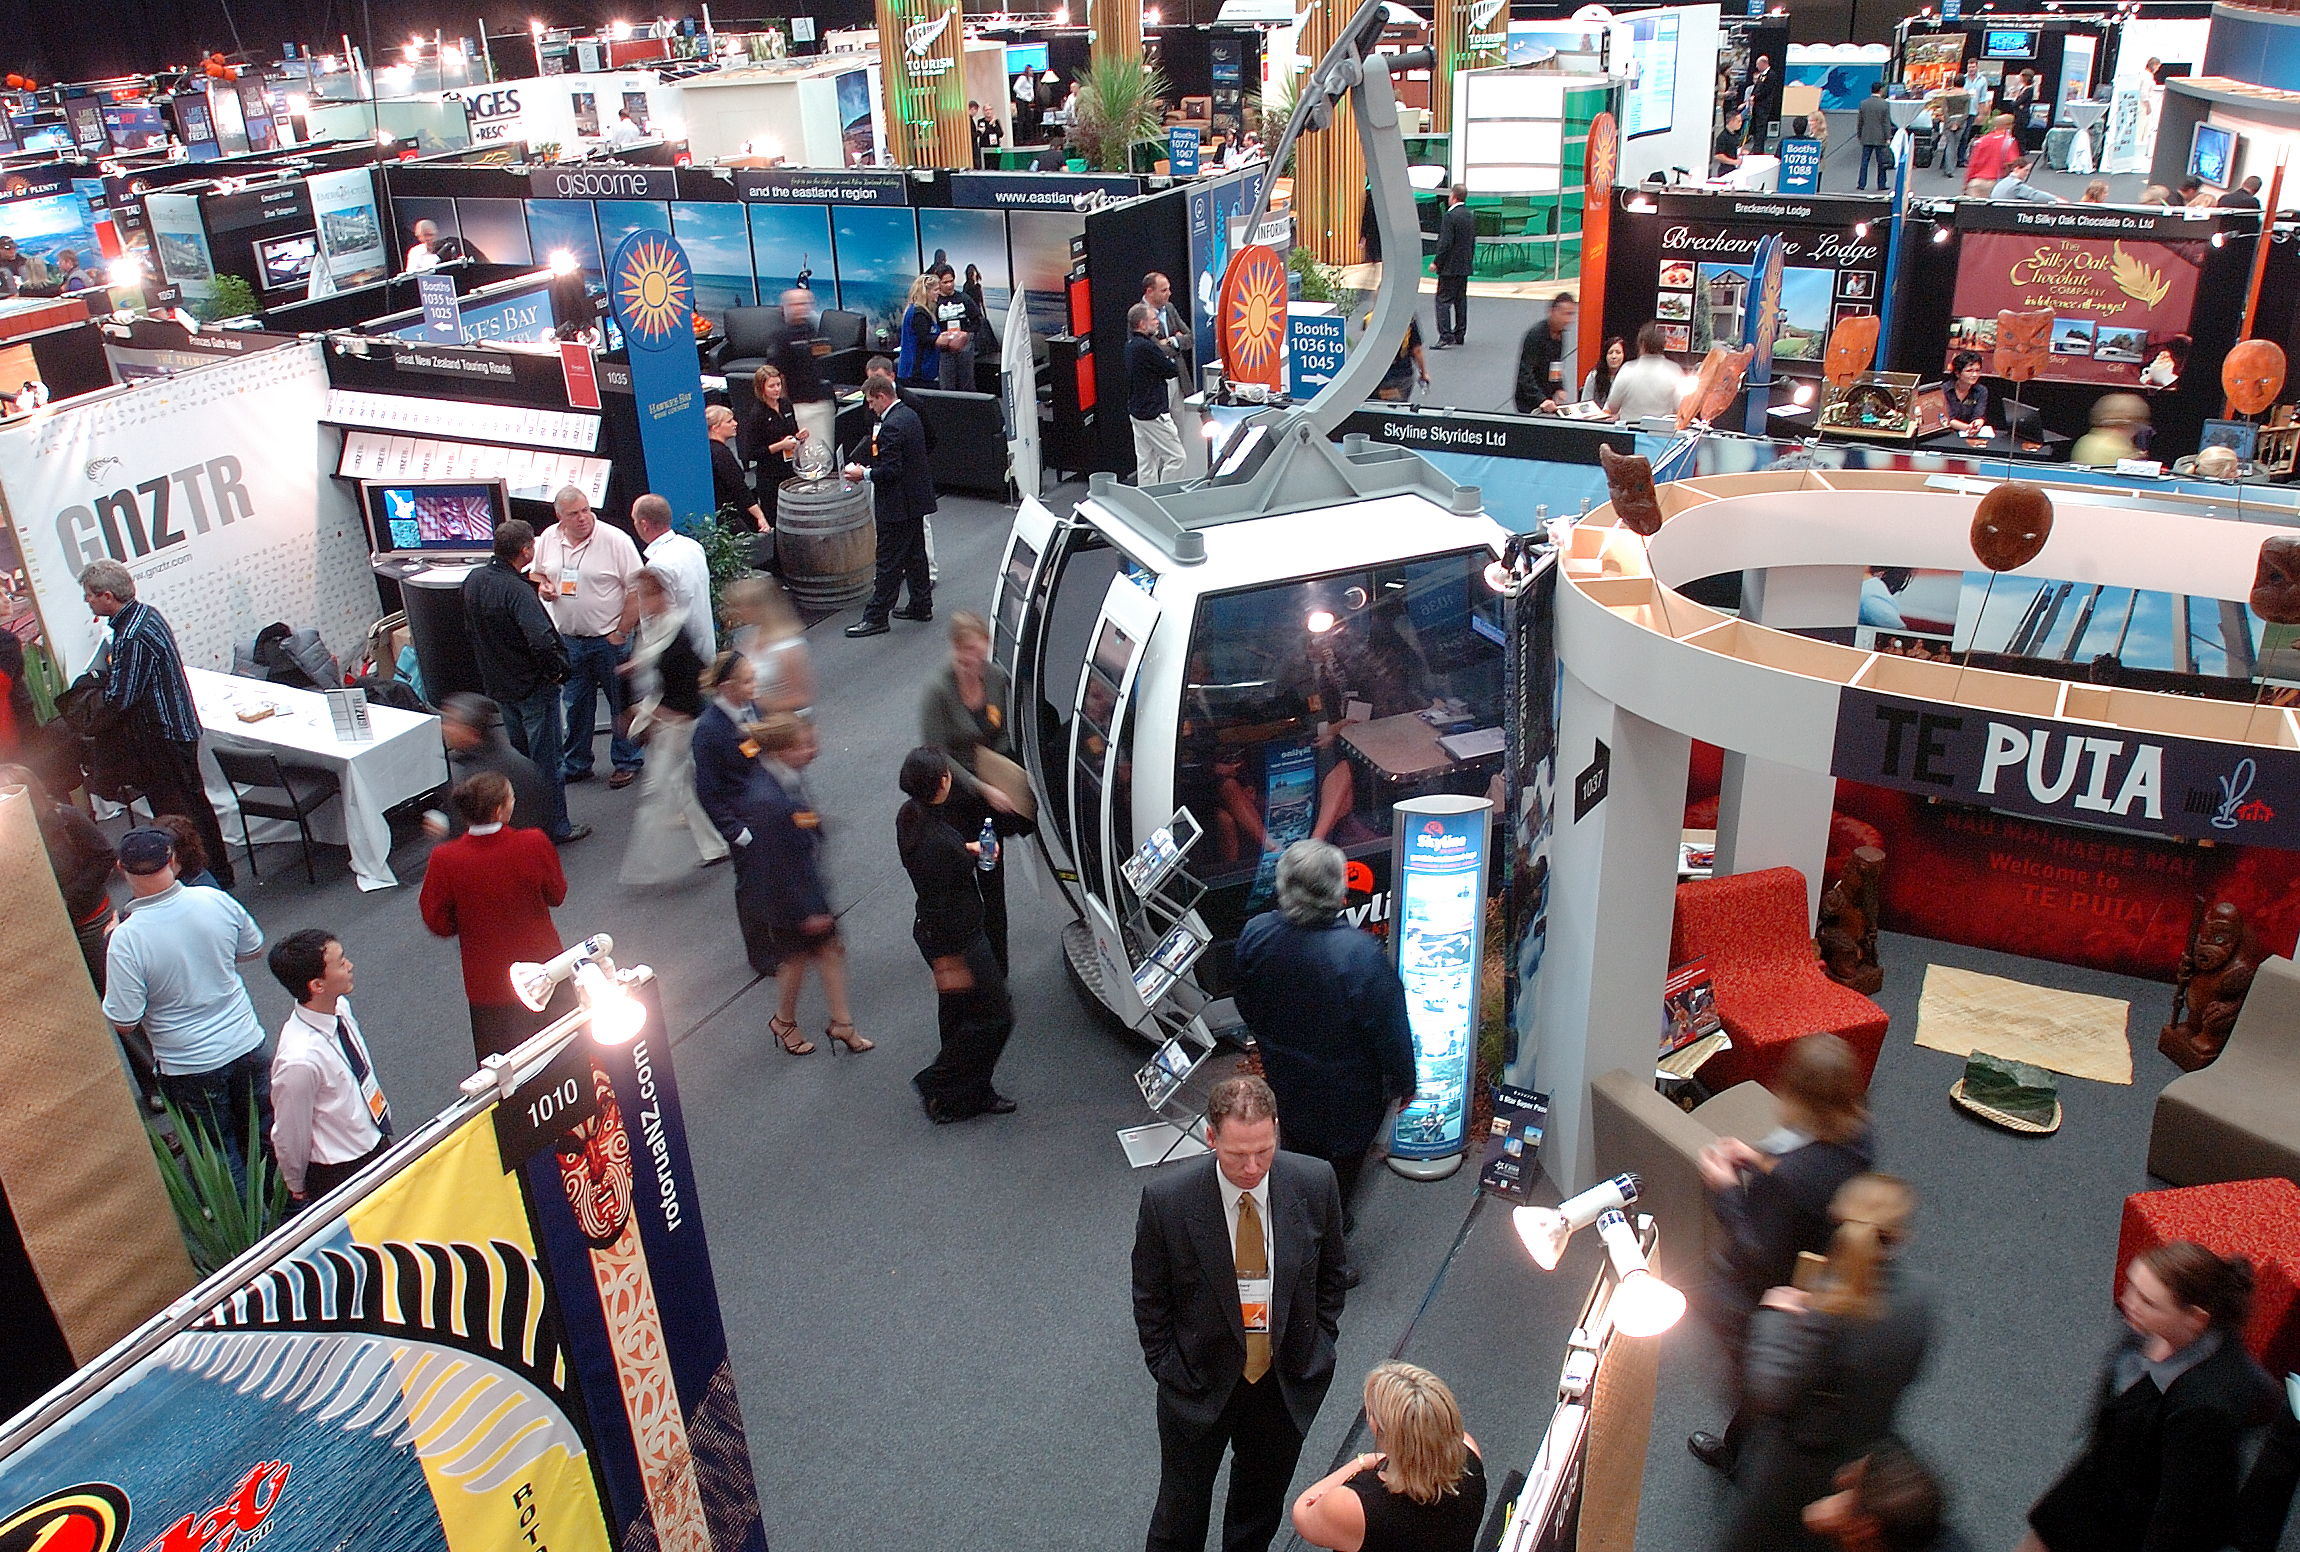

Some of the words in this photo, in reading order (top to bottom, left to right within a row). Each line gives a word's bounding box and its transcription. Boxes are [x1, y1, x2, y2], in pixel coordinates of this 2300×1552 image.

[905, 57, 955, 71] TOURISM
[1787, 143, 1817, 154] Booths
[1784, 154, 1807, 164] 1078
[1808, 155, 1819, 165] to
[29, 183, 60, 195] PLENTY
[556, 169, 648, 199] gisborne
[749, 187, 771, 198] and
[772, 186, 790, 198] the
[792, 186, 839, 199] eastland
[841, 187, 877, 202] region
[1735, 202, 1785, 217] Breckenridge
[1786, 204, 1811, 218] Lodge
[2017, 212, 2034, 224] The
[2034, 213, 2057, 227] Silky
[2058, 214, 2076, 225] Oak
[2077, 215, 2120, 228] Chocolate
[2121, 217, 2137, 229] Co.
[2138, 218, 2155, 230] Ltd
[1806, 233, 1878, 266] Lodge
[2061, 240, 2080, 252] The
[2027, 246, 2073, 273] Silky
[2074, 252, 2110, 271] Oak
[2010, 258, 2093, 286] Chocolate
[422, 280, 451, 292] Booths
[2049, 286, 2107, 297] COMPANY
[422, 294, 446, 306] 1035
[446, 296, 456, 307] to
[430, 307, 452, 320] 1025
[462, 317, 500, 344] KE'S
[1294, 322, 1340, 337] Booths
[1291, 337, 1326, 352] 1036
[1328, 339, 1344, 355] to
[395, 352, 416, 366] Great
[415, 355, 431, 367] New
[431, 356, 461, 371] Zealand
[460, 359, 489, 376] Touring
[489, 362, 512, 376] Route
[1300, 355, 1335, 370] 1045
[606, 372, 628, 386] 1035
[1383, 422, 1427, 441] Skyline
[1430, 427, 1484, 446] Skyrides
[1486, 430, 1507, 447] Ltd
[1519, 623, 1528, 768] rotoruaNZ.com
[1875, 704, 1963, 787] TE
[1977, 721, 2164, 820] PUIA
[1582, 768, 1604, 800] 1037
[1416, 834, 1467, 852] Skyline
[1989, 851, 2088, 885] Welcome
[2096, 871, 2120, 890] to
[2022, 882, 2057, 908] TE
[2069, 890, 2143, 923] PUIA
[527, 1078, 578, 1128] 1010
[633, 1039, 682, 1233] rotoruaNZ.com
[511, 1482, 548, 1552] ROT
